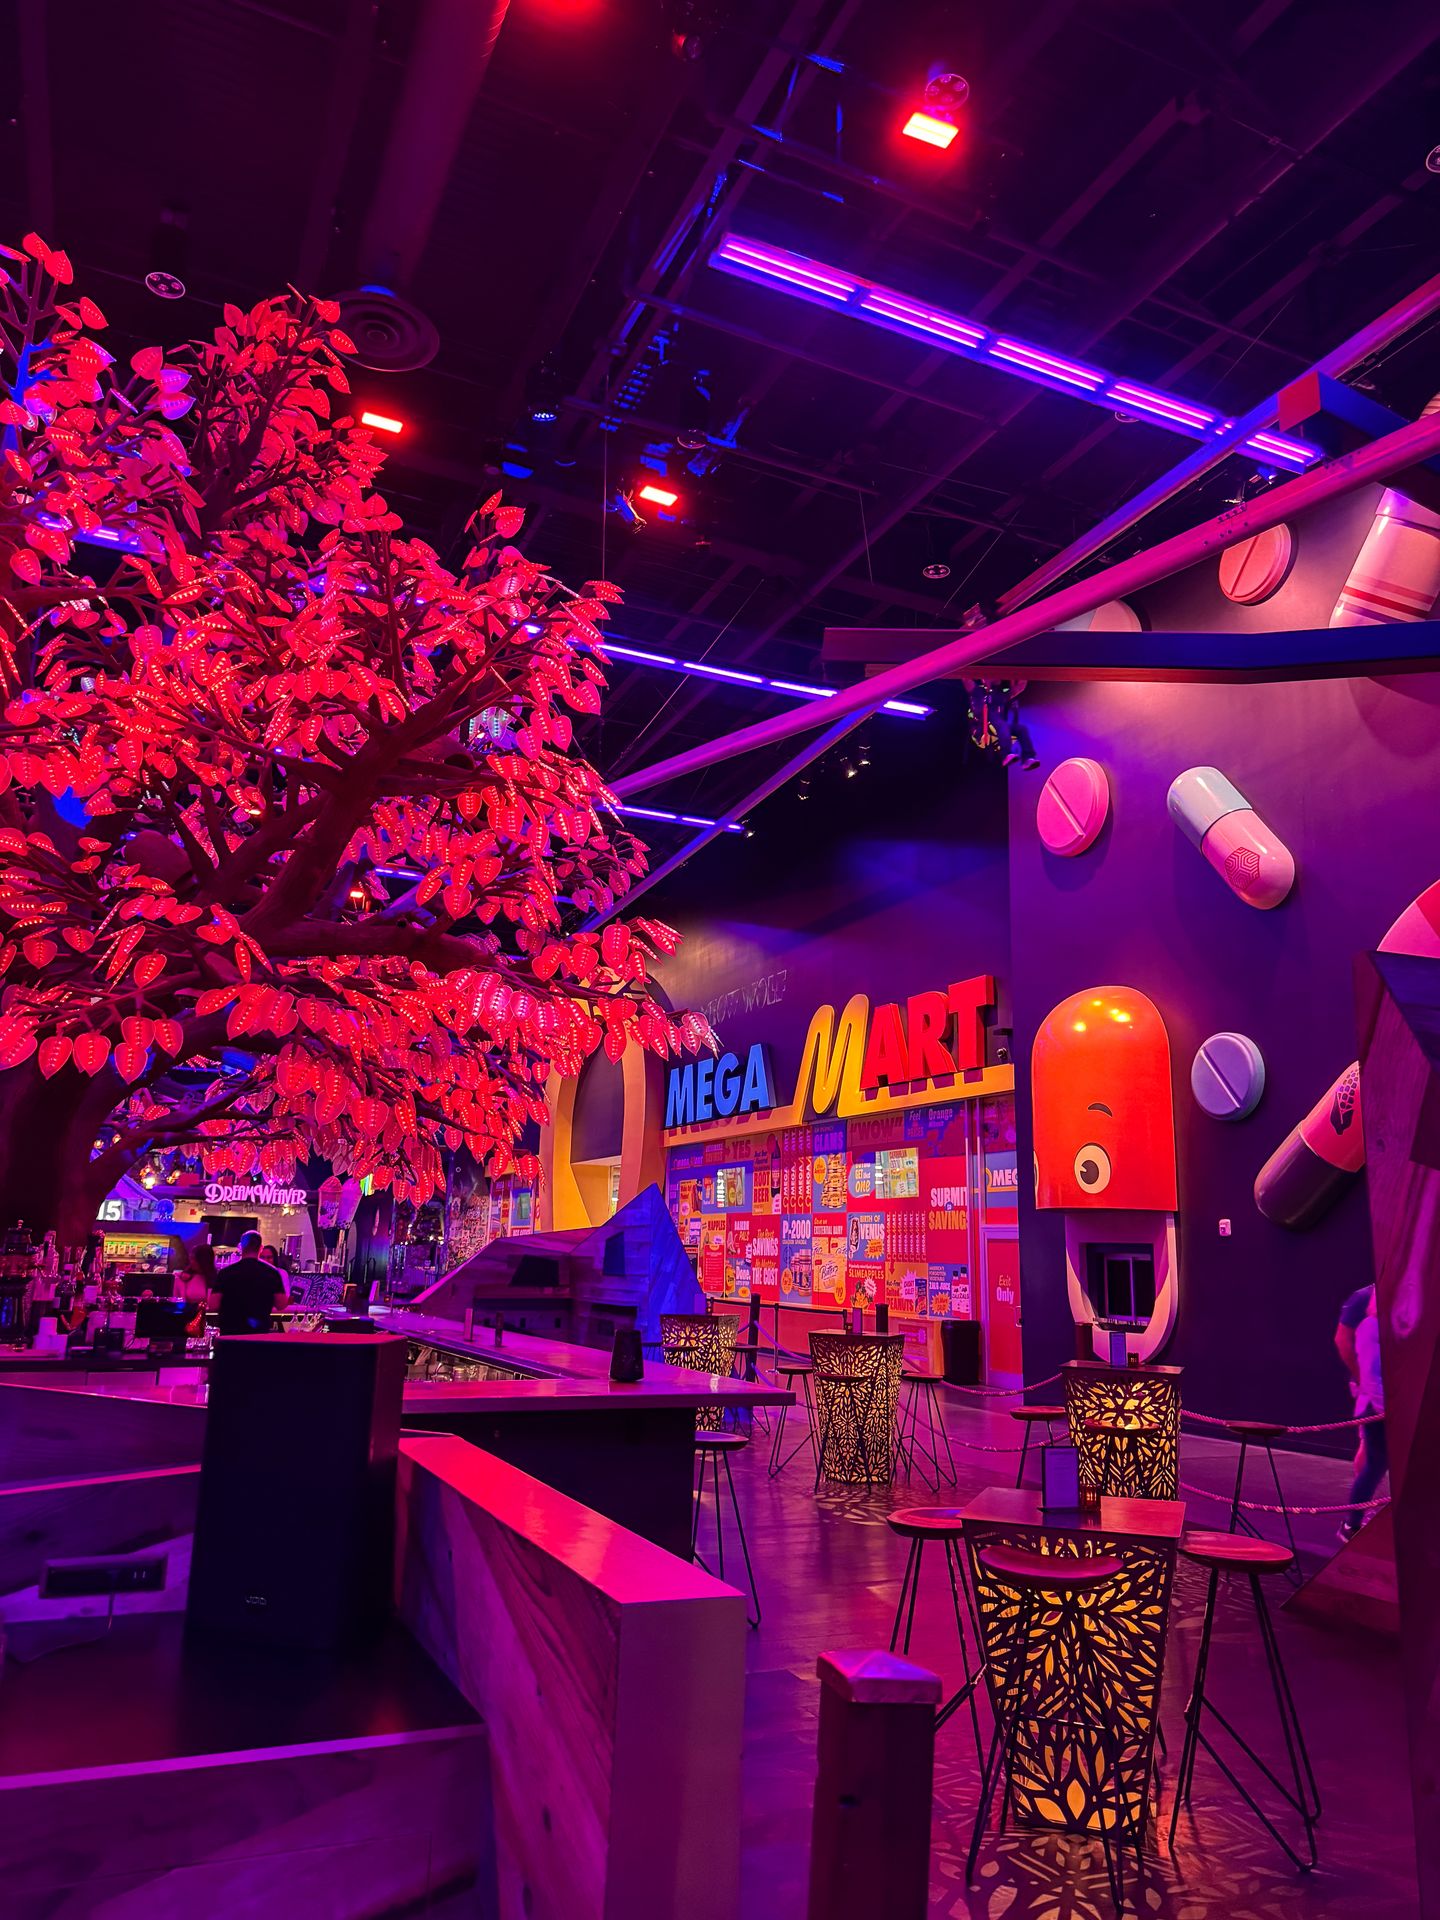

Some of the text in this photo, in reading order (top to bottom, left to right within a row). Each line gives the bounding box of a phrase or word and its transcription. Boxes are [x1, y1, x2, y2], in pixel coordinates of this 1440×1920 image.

[665, 974, 995, 1128] MEGA MART
[731, 1140, 752, 1159] YES
[754, 1171, 771, 1187] ROOT
[855, 1168, 863, 1180] GET
[754, 1188, 770, 1203] BEER
[930, 1186, 968, 1208] SUBMIT
[860, 1214, 881, 1223] BIRTH OF
[782, 1219, 811, 1240] P-2000
[860, 1223, 885, 1240] VENUS
[752, 1237, 779, 1257] SAVINGS
[752, 1267, 763, 1285] THE
[763, 1268, 778, 1286] COST
[998, 1274, 1011, 1287] Exit
[996, 1286, 1015, 1305] Only
[886, 1297, 915, 1313] PEANUTS
